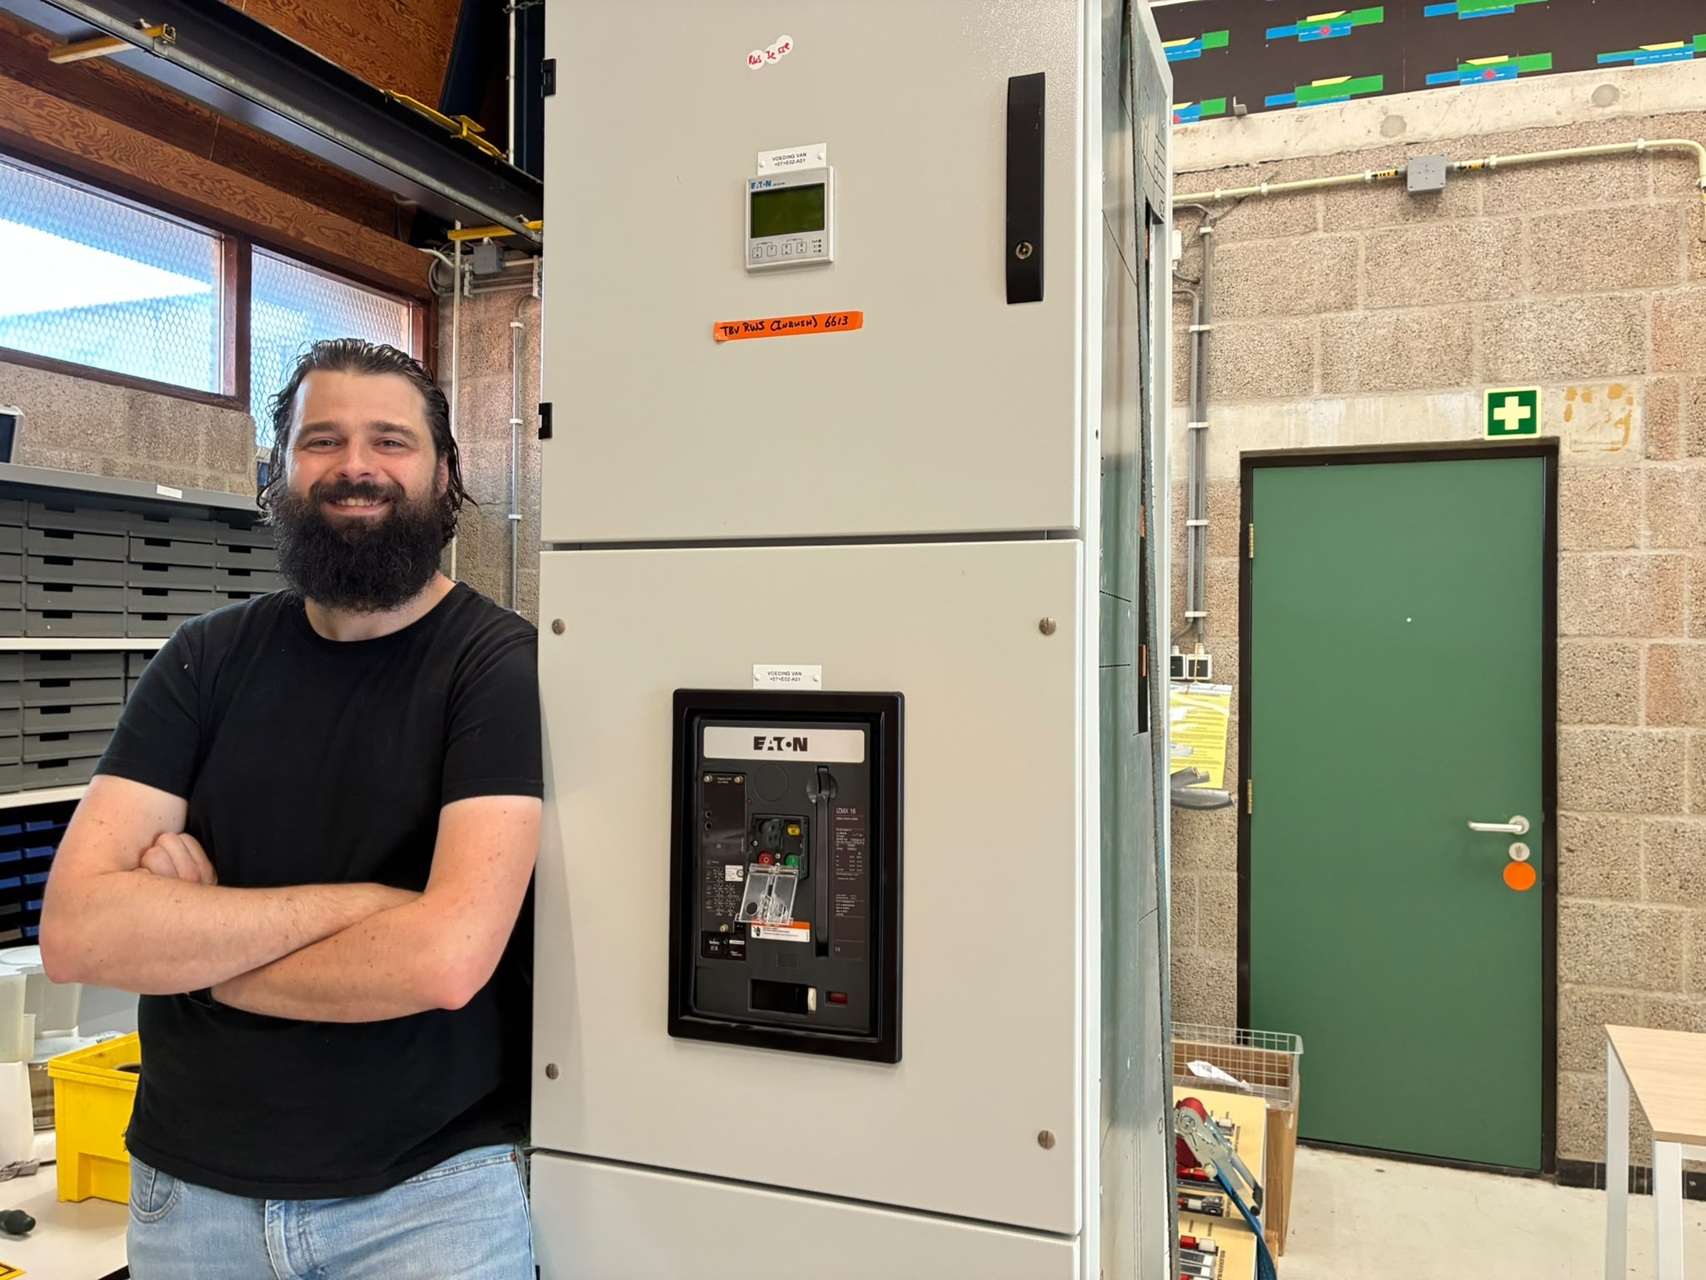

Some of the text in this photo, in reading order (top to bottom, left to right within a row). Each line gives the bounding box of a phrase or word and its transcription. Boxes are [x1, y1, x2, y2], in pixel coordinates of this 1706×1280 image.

[772, 154, 796, 162] VOEDING
[751, 180, 772, 190] EATON
[719, 325, 740, 336] TBV
[742, 320, 765, 332] RWS
[824, 315, 849, 328] 6613
[753, 736, 808, 752] EATON
